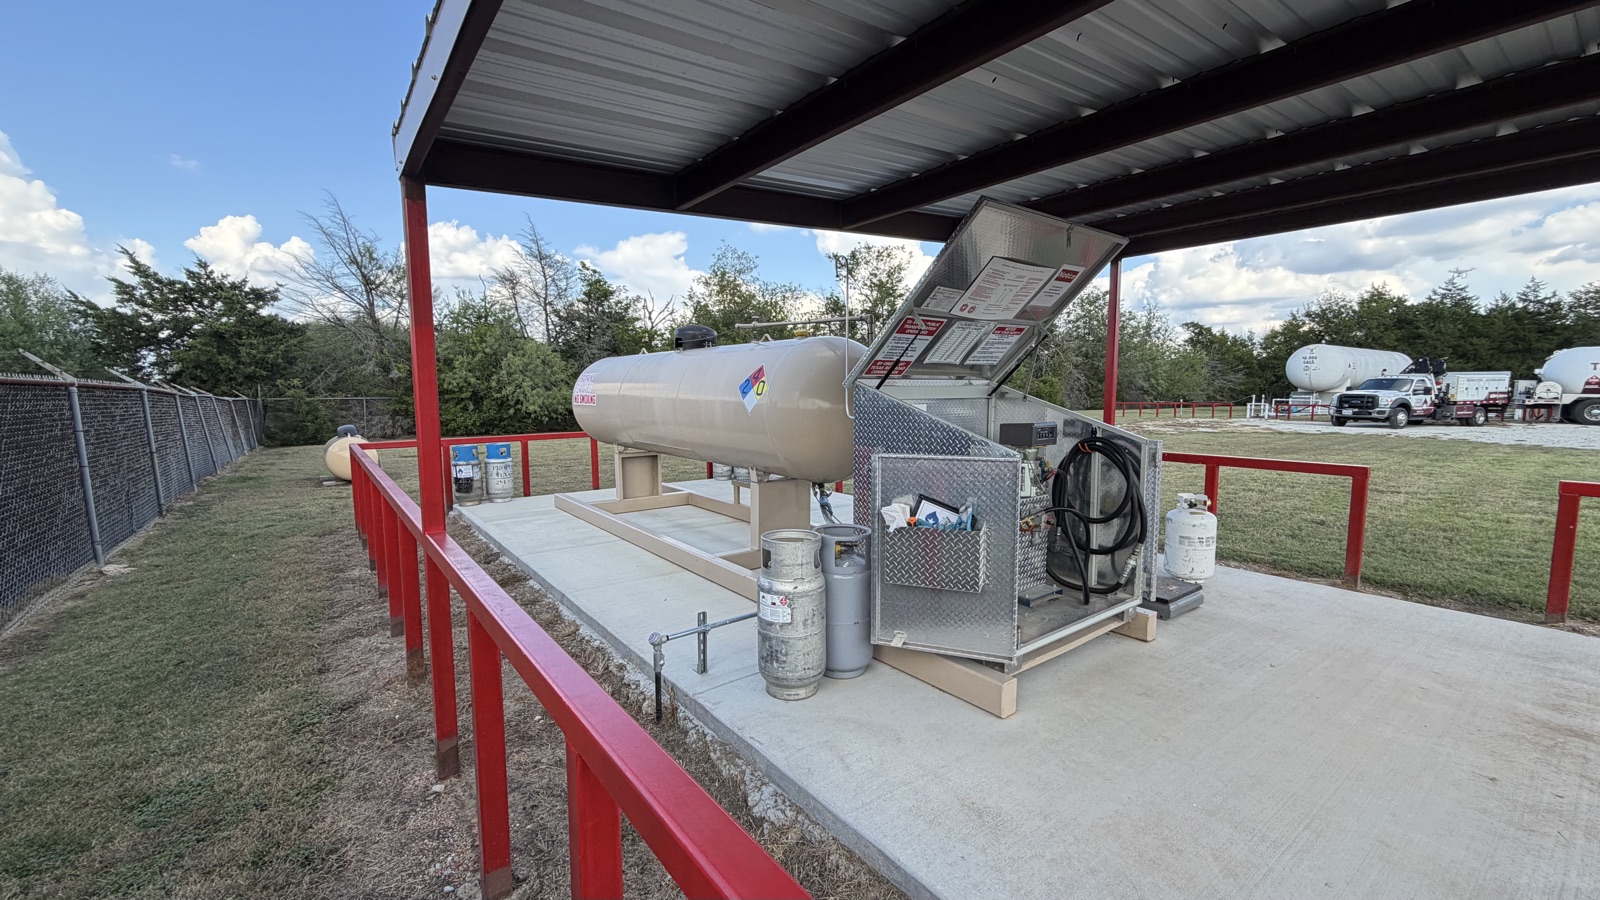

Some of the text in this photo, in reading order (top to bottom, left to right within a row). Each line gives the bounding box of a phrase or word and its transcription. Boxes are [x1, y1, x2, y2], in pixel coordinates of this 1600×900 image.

[753, 367, 763, 382] 4
[741, 378, 750, 395] 2
[755, 379, 766, 396] 0
